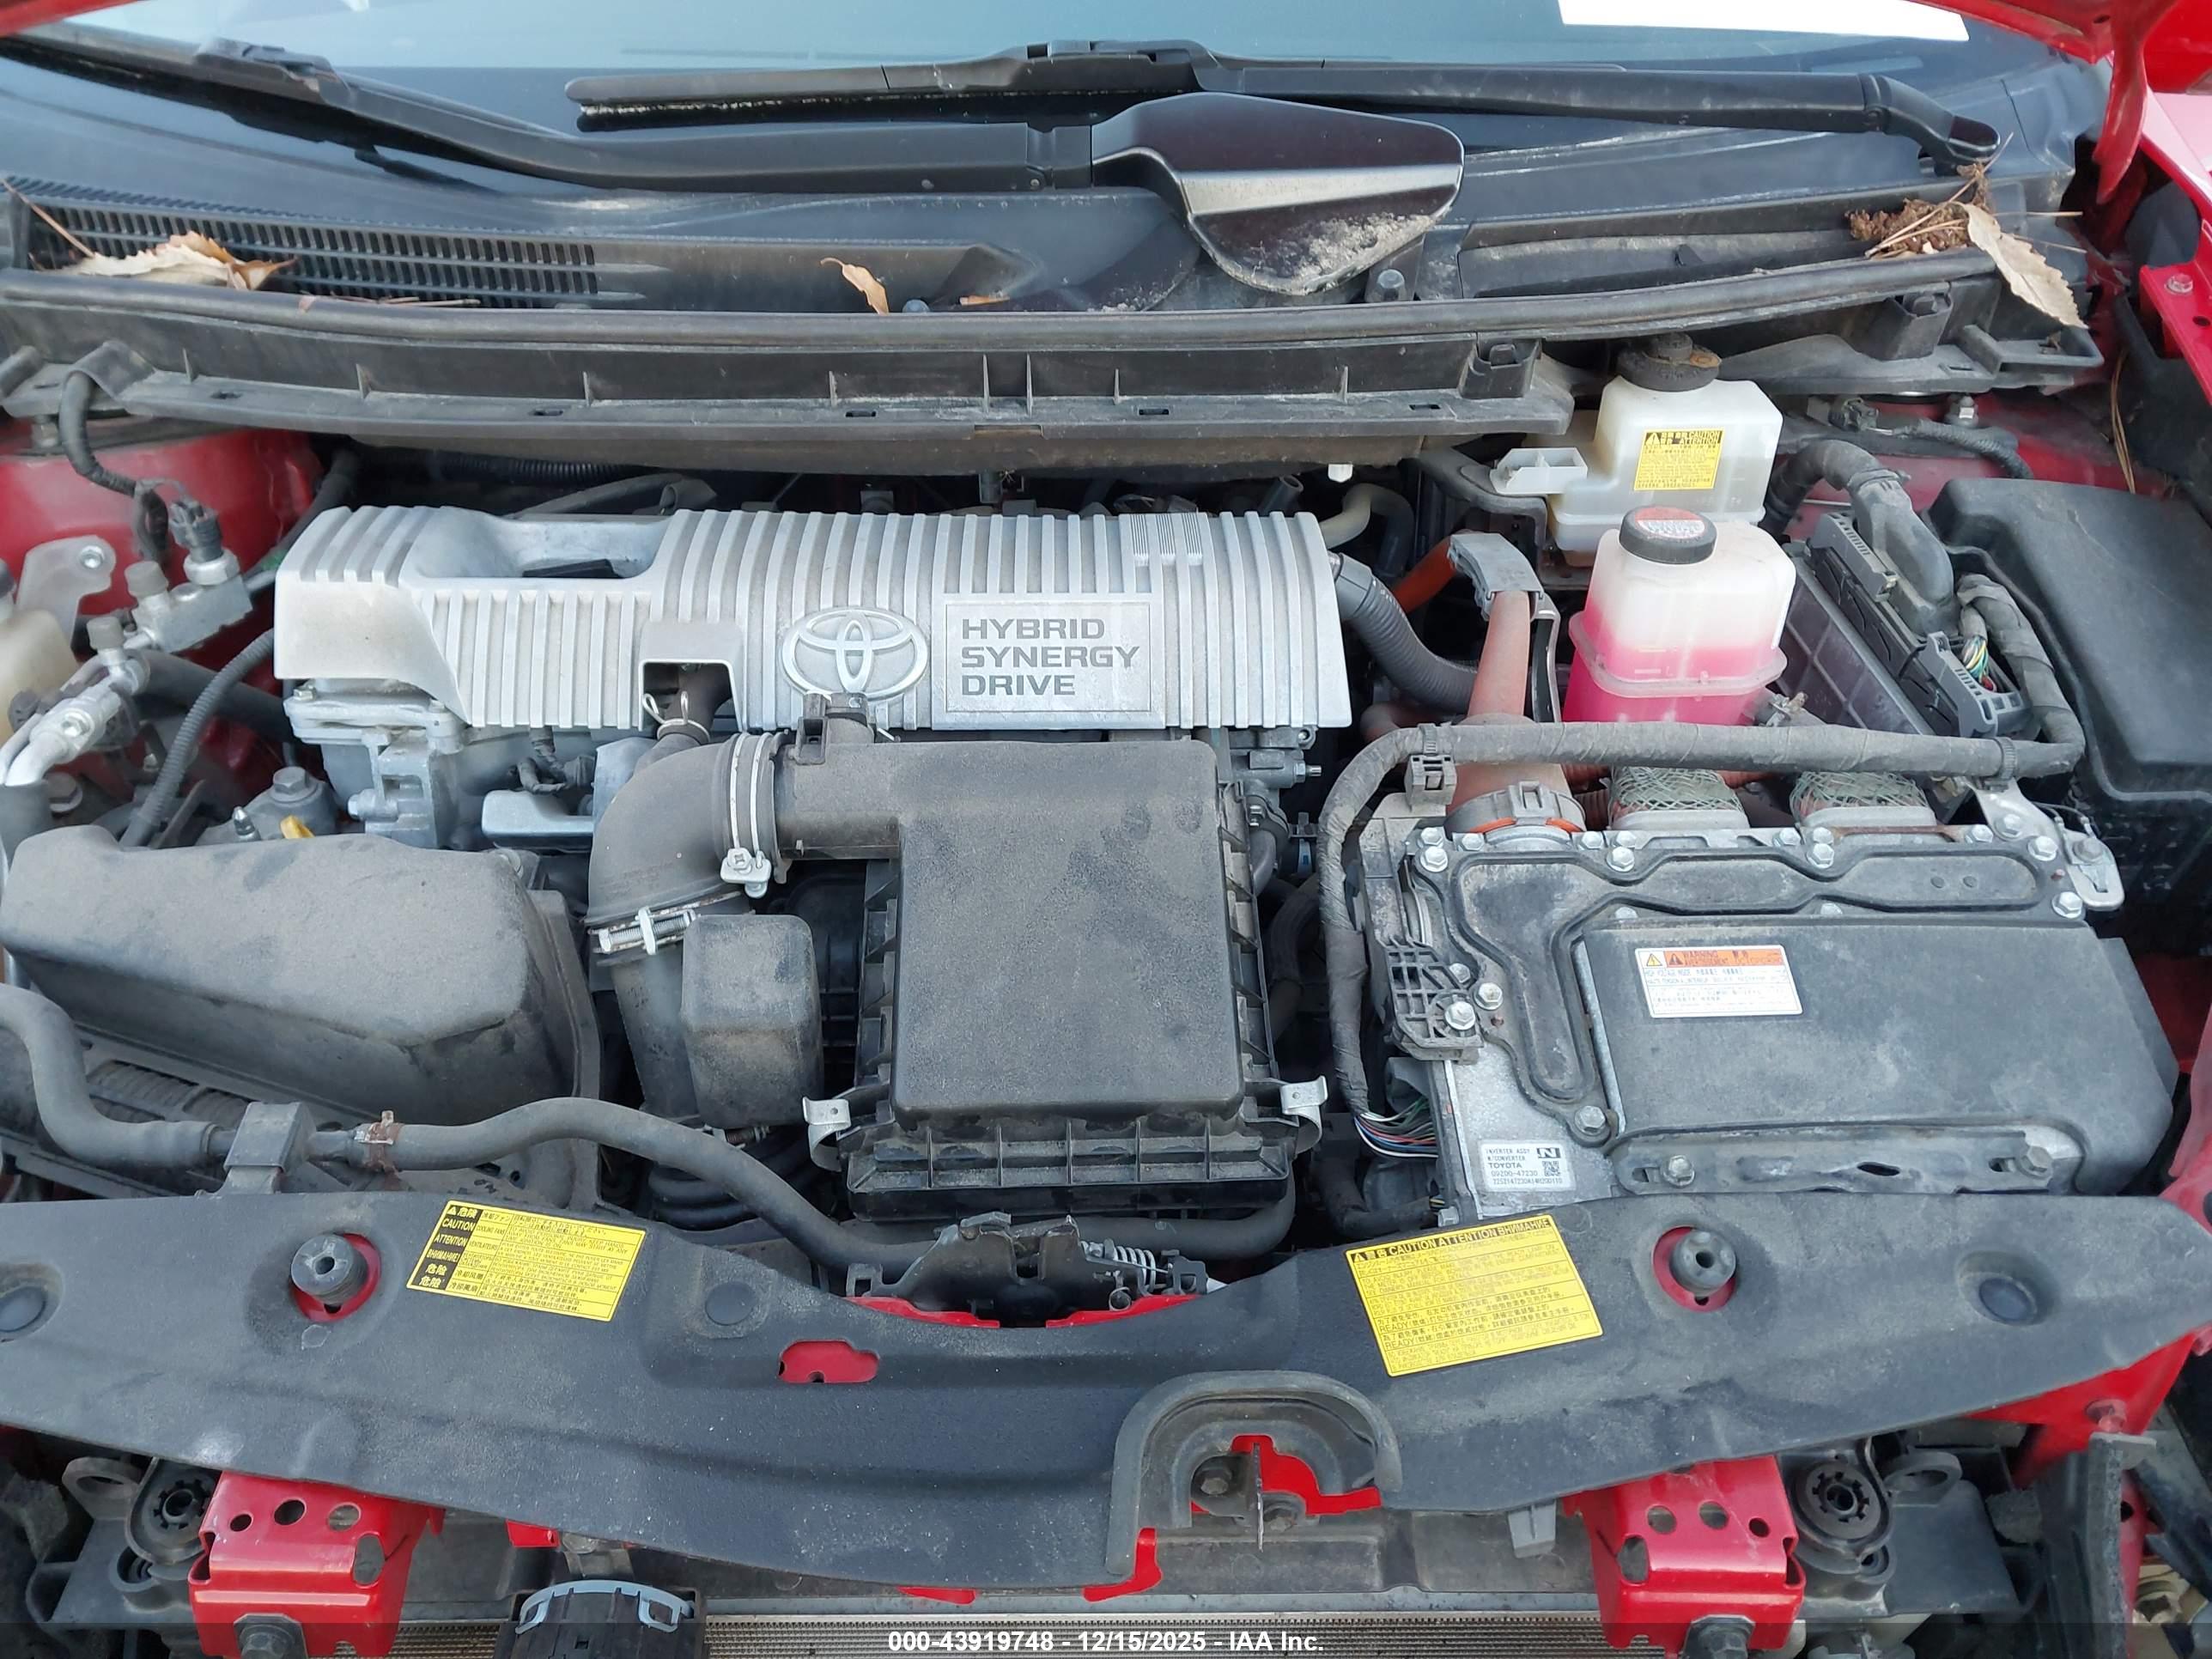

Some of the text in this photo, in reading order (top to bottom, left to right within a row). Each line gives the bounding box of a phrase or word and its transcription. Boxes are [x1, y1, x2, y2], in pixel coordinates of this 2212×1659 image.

[962, 618, 1106, 640] HYBRID
[962, 646, 1139, 668] SYNERGY
[962, 675, 1076, 696] DRIVE
[441, 1218, 475, 1231] CAUTION
[433, 1233, 468, 1246] ATTENTION
[1387, 1239, 1437, 1256] CAUTION
[1437, 1229, 1498, 1247] ATTENTION
